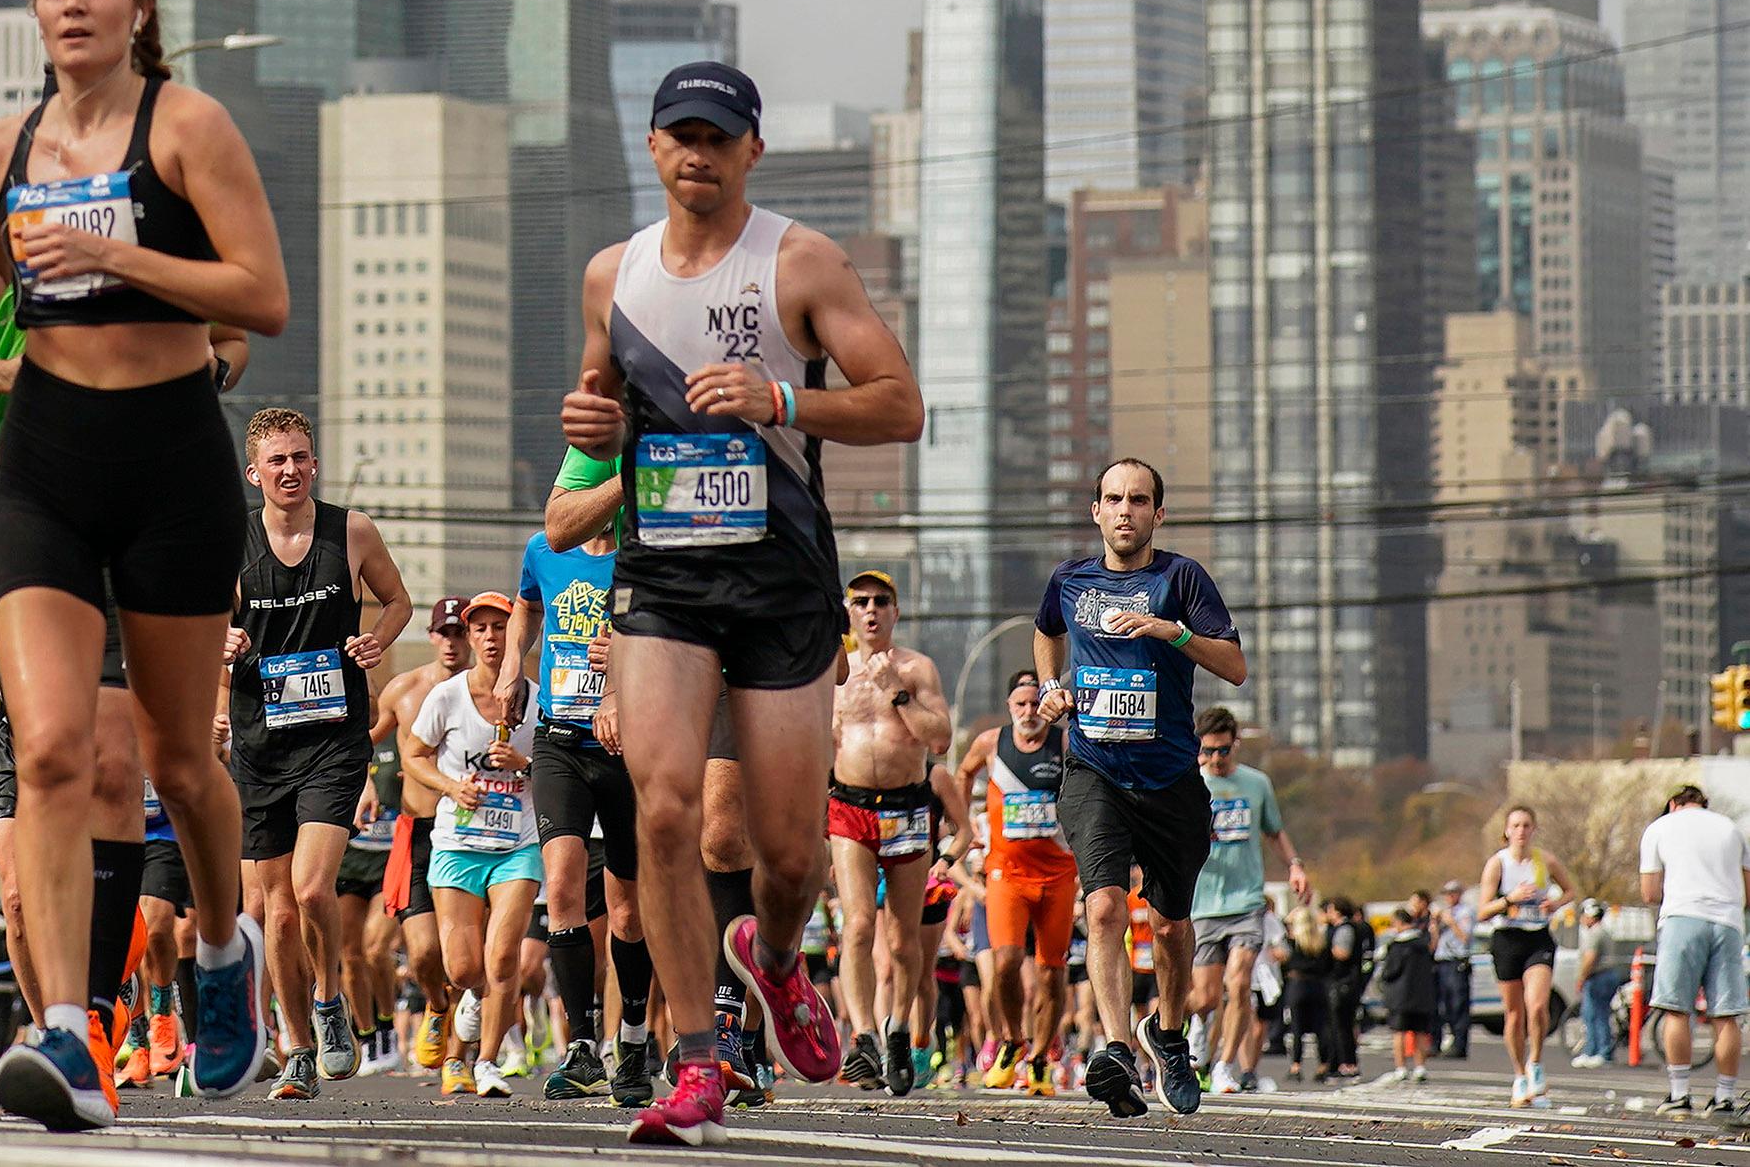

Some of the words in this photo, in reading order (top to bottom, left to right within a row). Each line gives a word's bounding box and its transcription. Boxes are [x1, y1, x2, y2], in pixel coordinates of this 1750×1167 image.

[709, 305, 759, 332] NYC
[717, 333, 761, 358] '22
[650, 444, 676, 462] tcs
[694, 471, 750, 507] 4500
[250, 590, 327, 609] RELEASE
[268, 662, 286, 674] tcs
[301, 674, 331, 698] 7415
[1084, 672, 1100, 685] tcs
[271, 693, 280, 701] D
[1110, 693, 1146, 716] 11584
[484, 810, 514, 830] 13491
